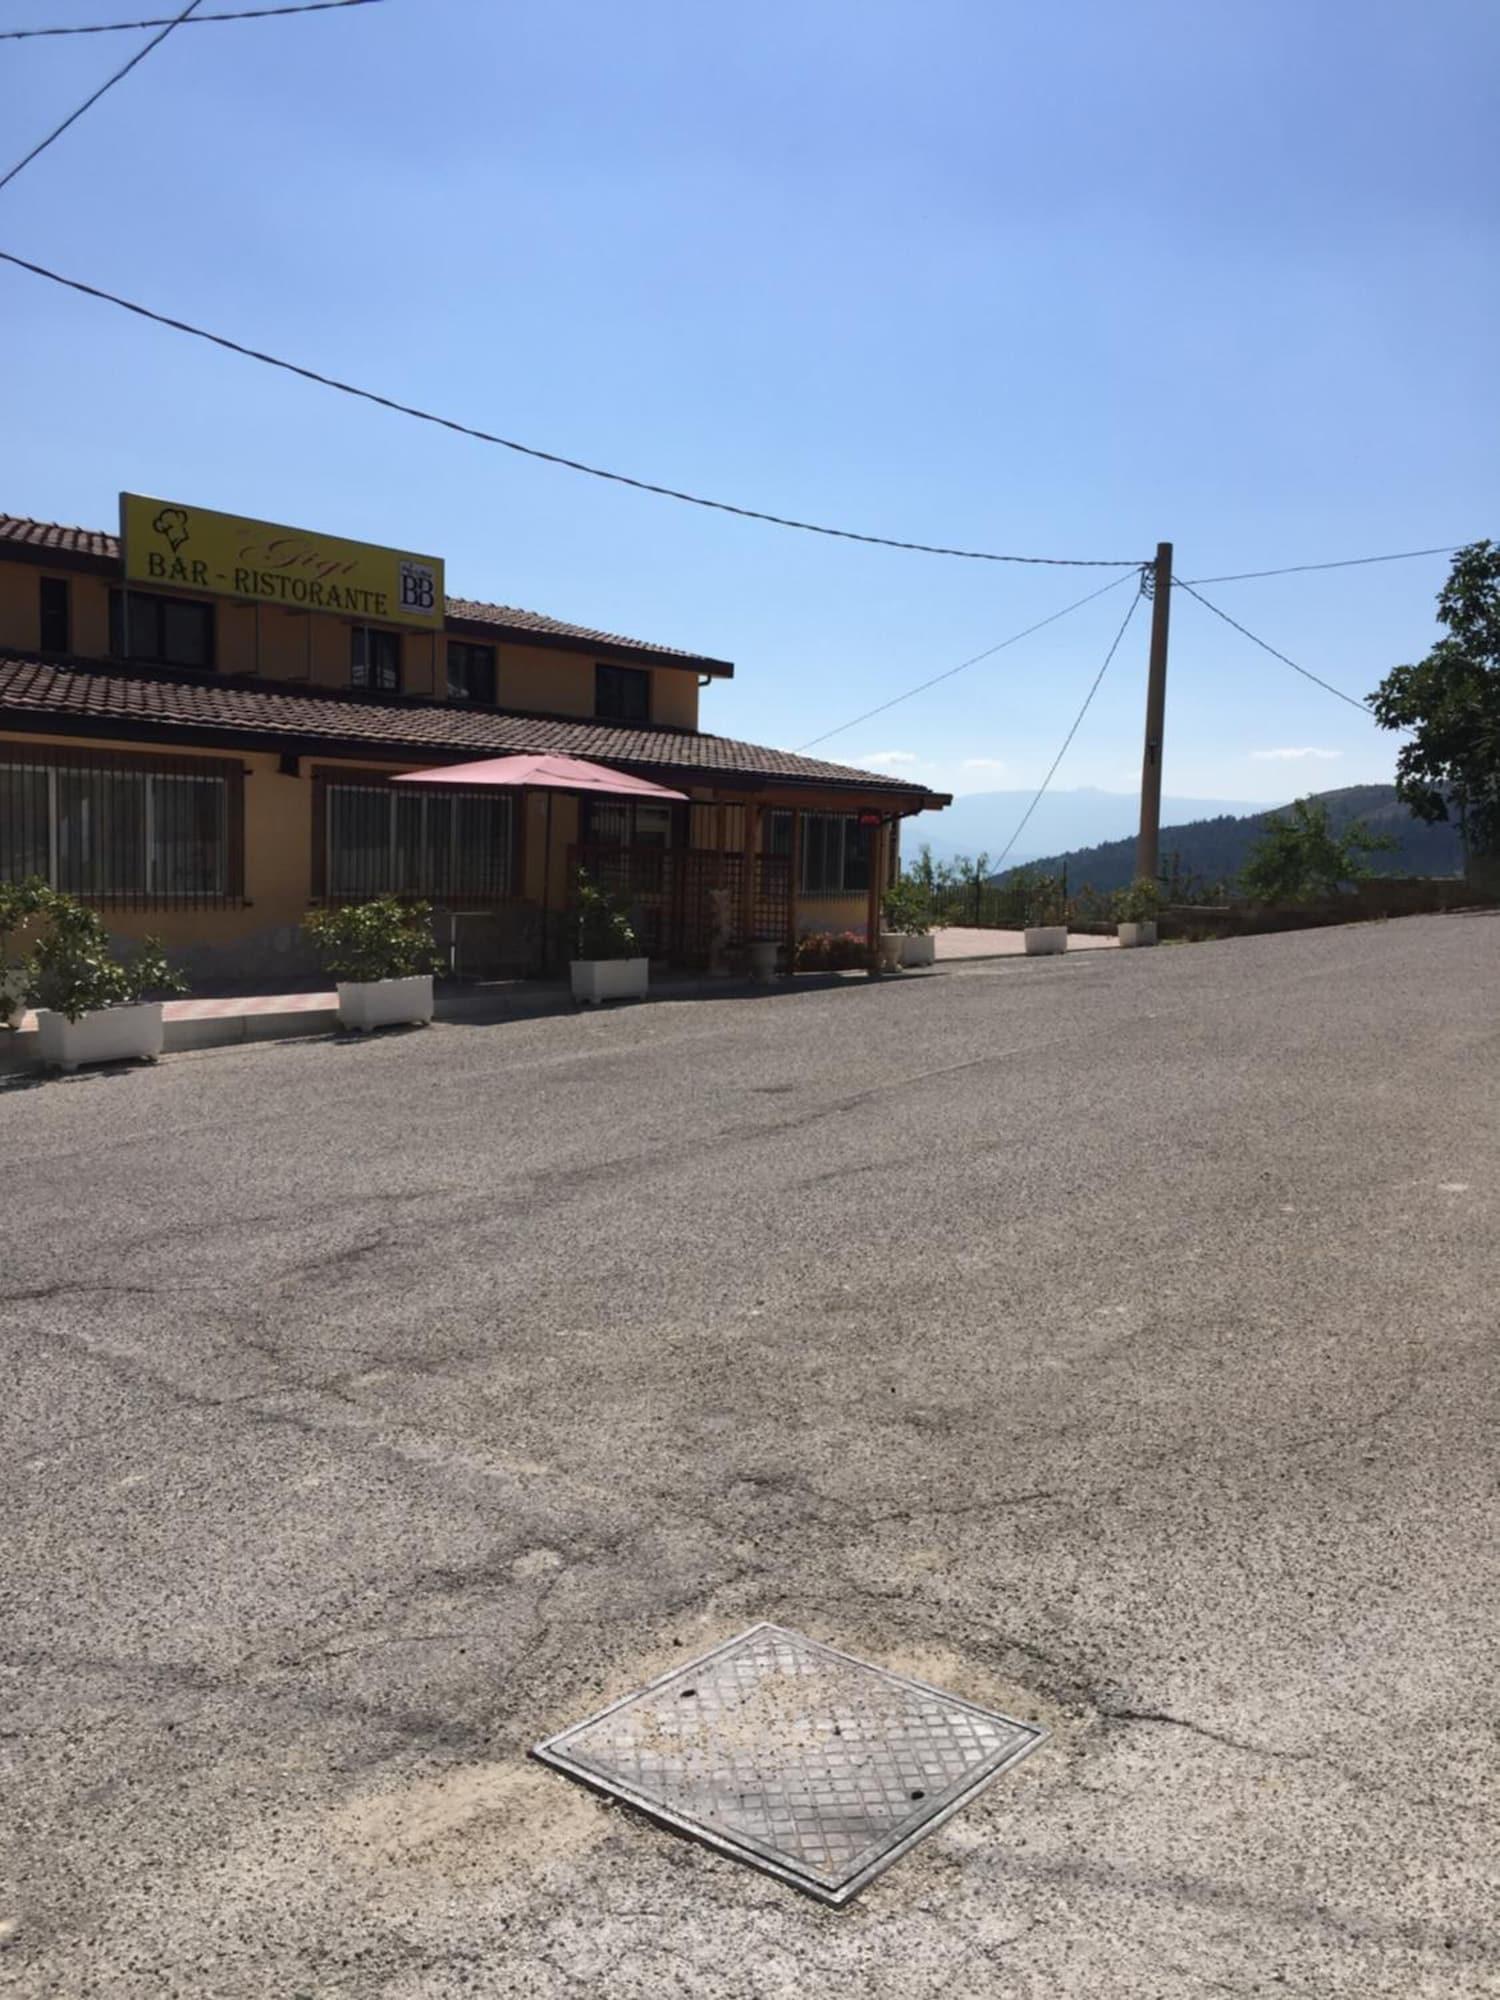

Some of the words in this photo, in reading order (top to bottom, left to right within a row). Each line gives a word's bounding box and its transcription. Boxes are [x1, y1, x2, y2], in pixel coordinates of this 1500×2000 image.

[148, 552, 208, 586] BAR
[234, 568, 388, 616] RISTORANTE
[402, 574, 434, 609] BB
